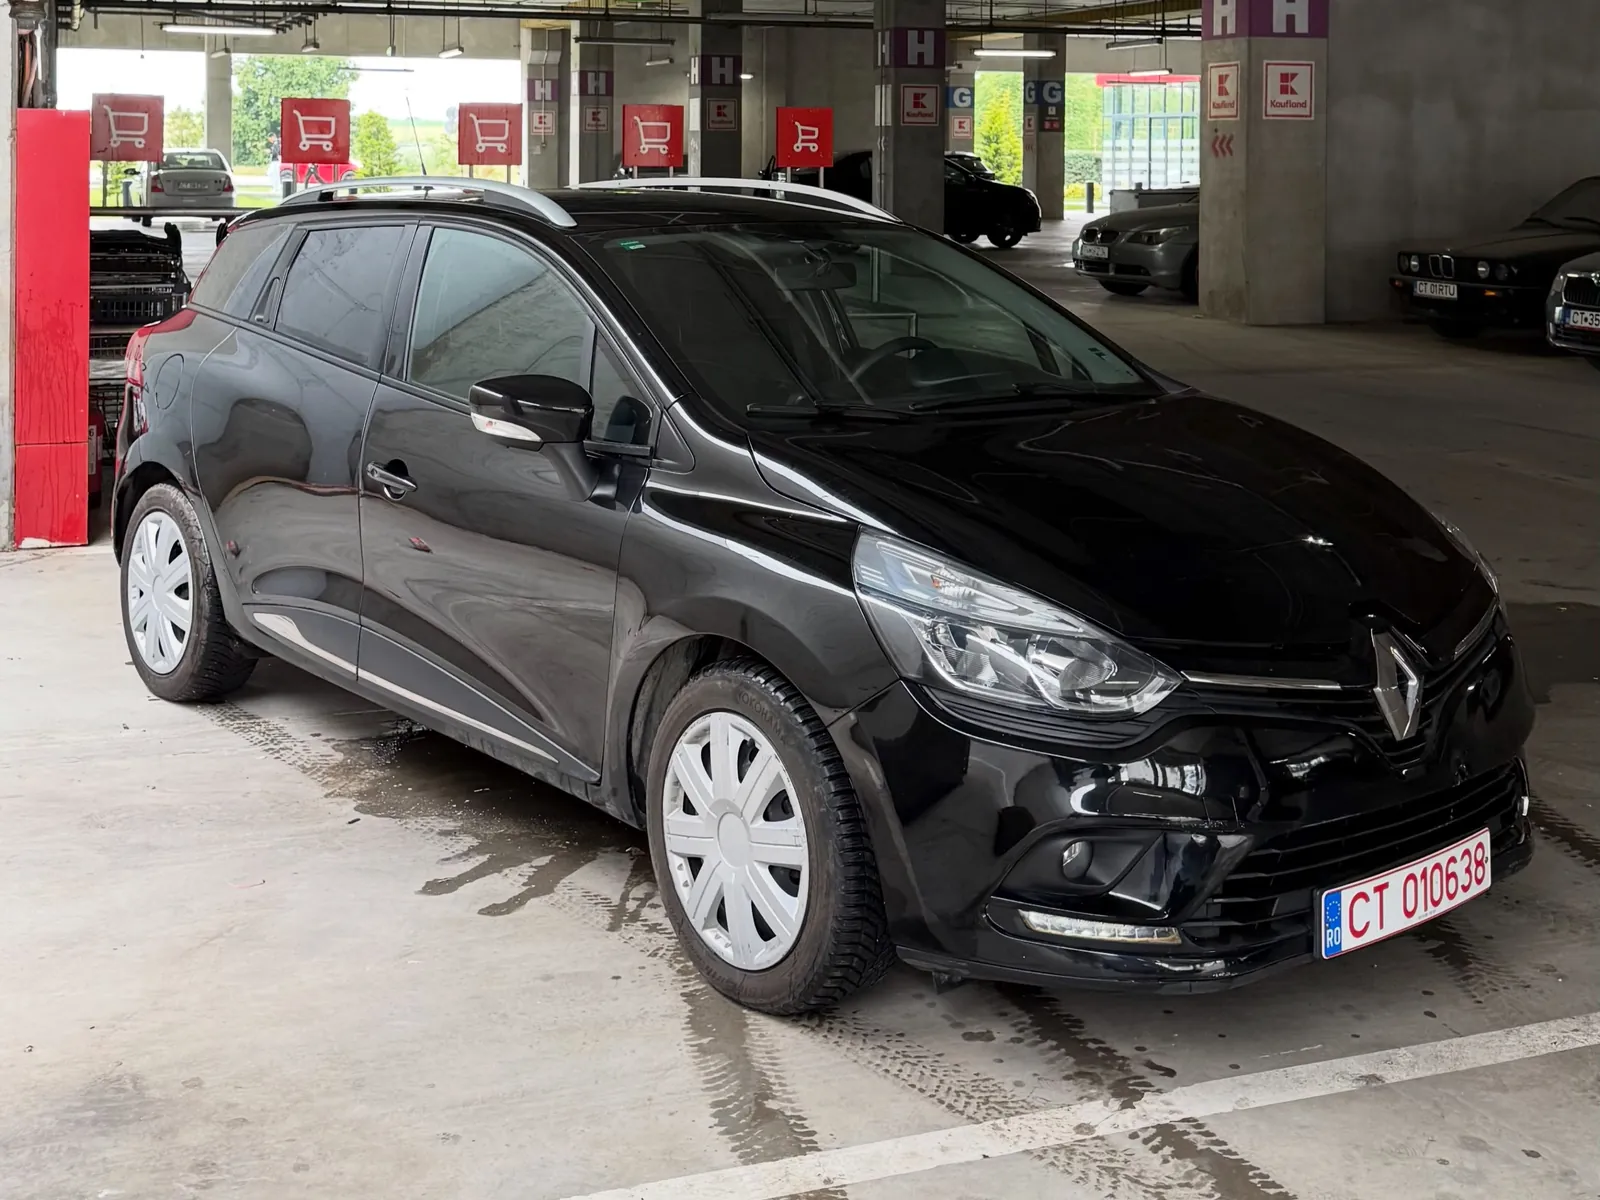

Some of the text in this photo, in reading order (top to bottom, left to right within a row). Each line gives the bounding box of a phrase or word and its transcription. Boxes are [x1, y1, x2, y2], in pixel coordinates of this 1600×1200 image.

[1213, 0, 1236, 36] H
[1273, 0, 1309, 33] H
[907, 30, 935, 65] H
[690, 56, 699, 85] H
[711, 56, 734, 85] H
[534, 79, 552, 101] H
[587, 71, 606, 95] H
[1025, 81, 1036, 104] G
[1042, 81, 1062, 104] G
[953, 87, 972, 108] G
[1270, 99, 1307, 109] Kaufland
[1418, 281, 1428, 294] CT
[1572, 311, 1585, 325] CT
[1349, 841, 1486, 938] CT 010638
[1326, 927, 1341, 948] RO
